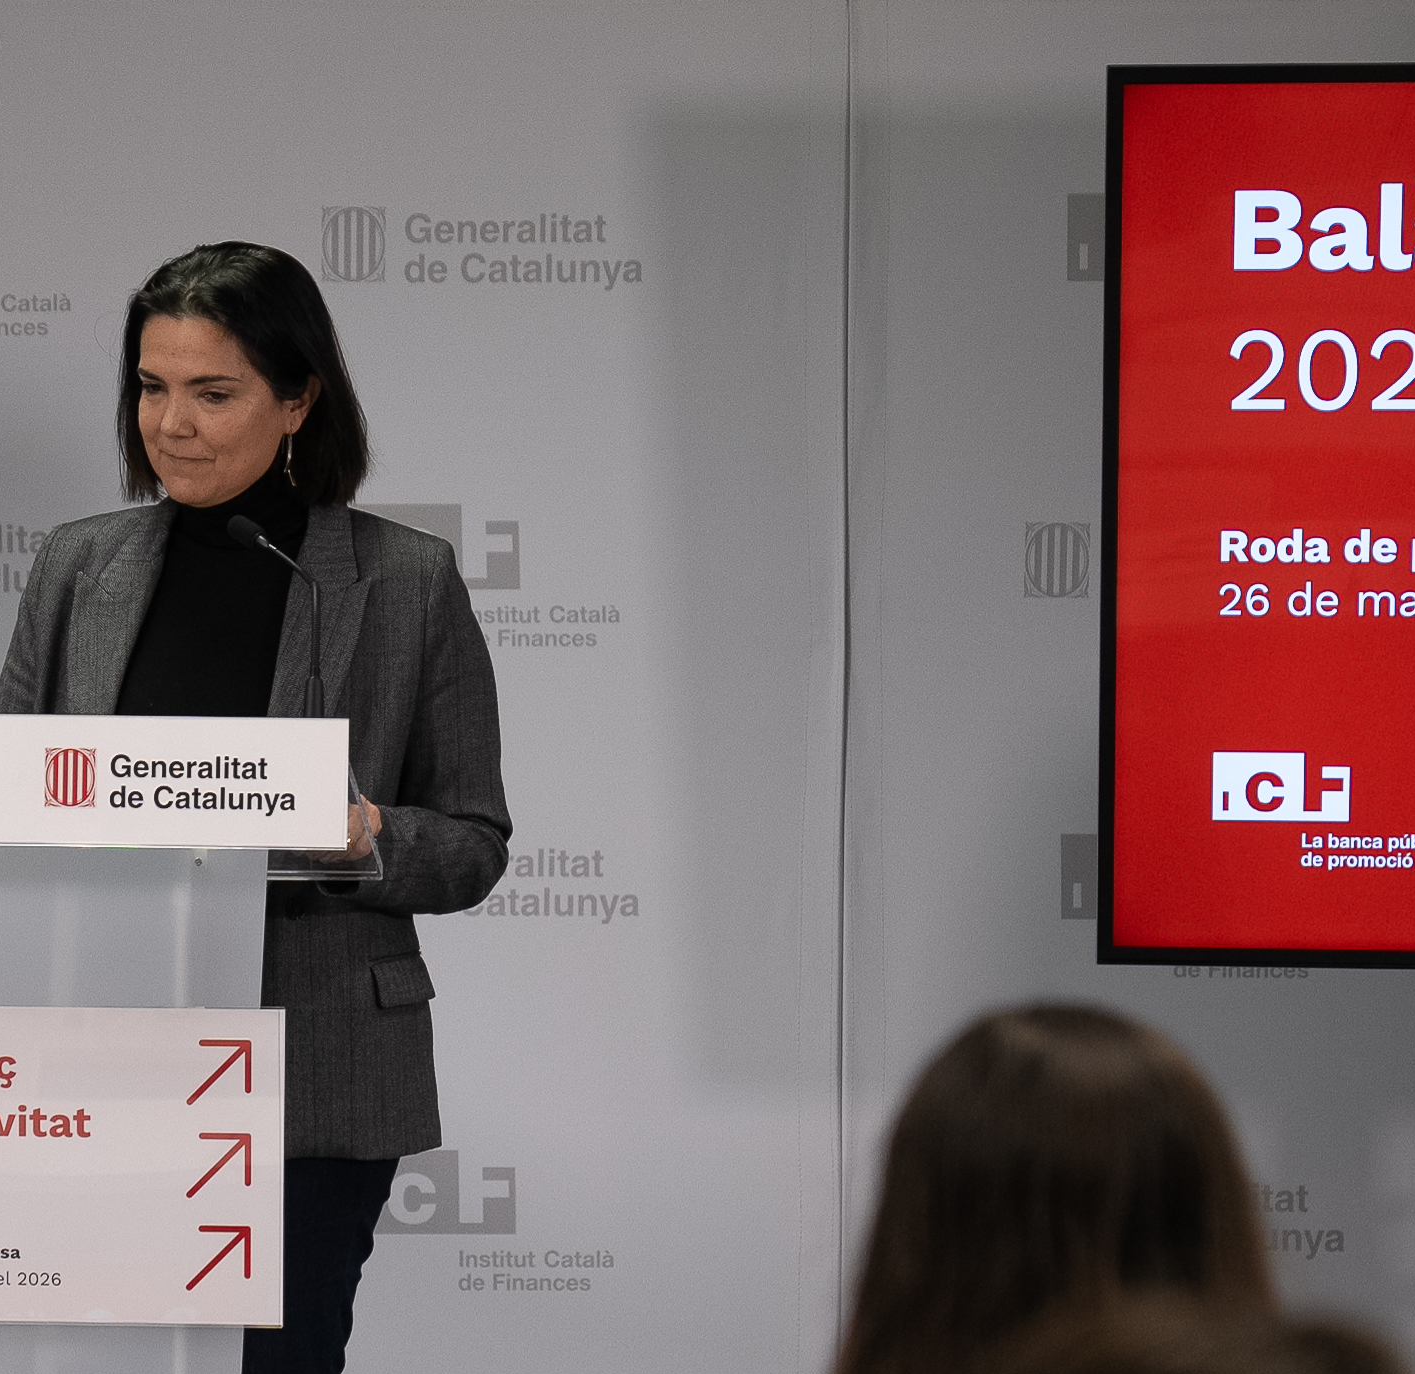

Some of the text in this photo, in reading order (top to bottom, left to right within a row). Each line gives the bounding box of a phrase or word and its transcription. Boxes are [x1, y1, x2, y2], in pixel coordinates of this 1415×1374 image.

[404, 212, 607, 244] Generalitat
[403, 252, 644, 292] de Catalunya
[0, 293, 72, 313] Català
[1220, 528, 1331, 563] Roda
[1343, 528, 1398, 564] de
[1219, 583, 1270, 617] 26
[1287, 581, 1339, 617] de
[548, 604, 621, 624] Català
[497, 628, 598, 648] Finances
[110, 753, 268, 780] Generalitat
[109, 785, 295, 817] de Catalunya
[1301, 832, 1323, 849] La
[1327, 833, 1383, 849] banca
[509, 848, 604, 878] alitat
[1300, 851, 1414, 871] de promoció
[458, 1249, 615, 1269] Institut Català
[17, 1271, 62, 1287] 2026
[457, 1272, 592, 1292] de Finances
